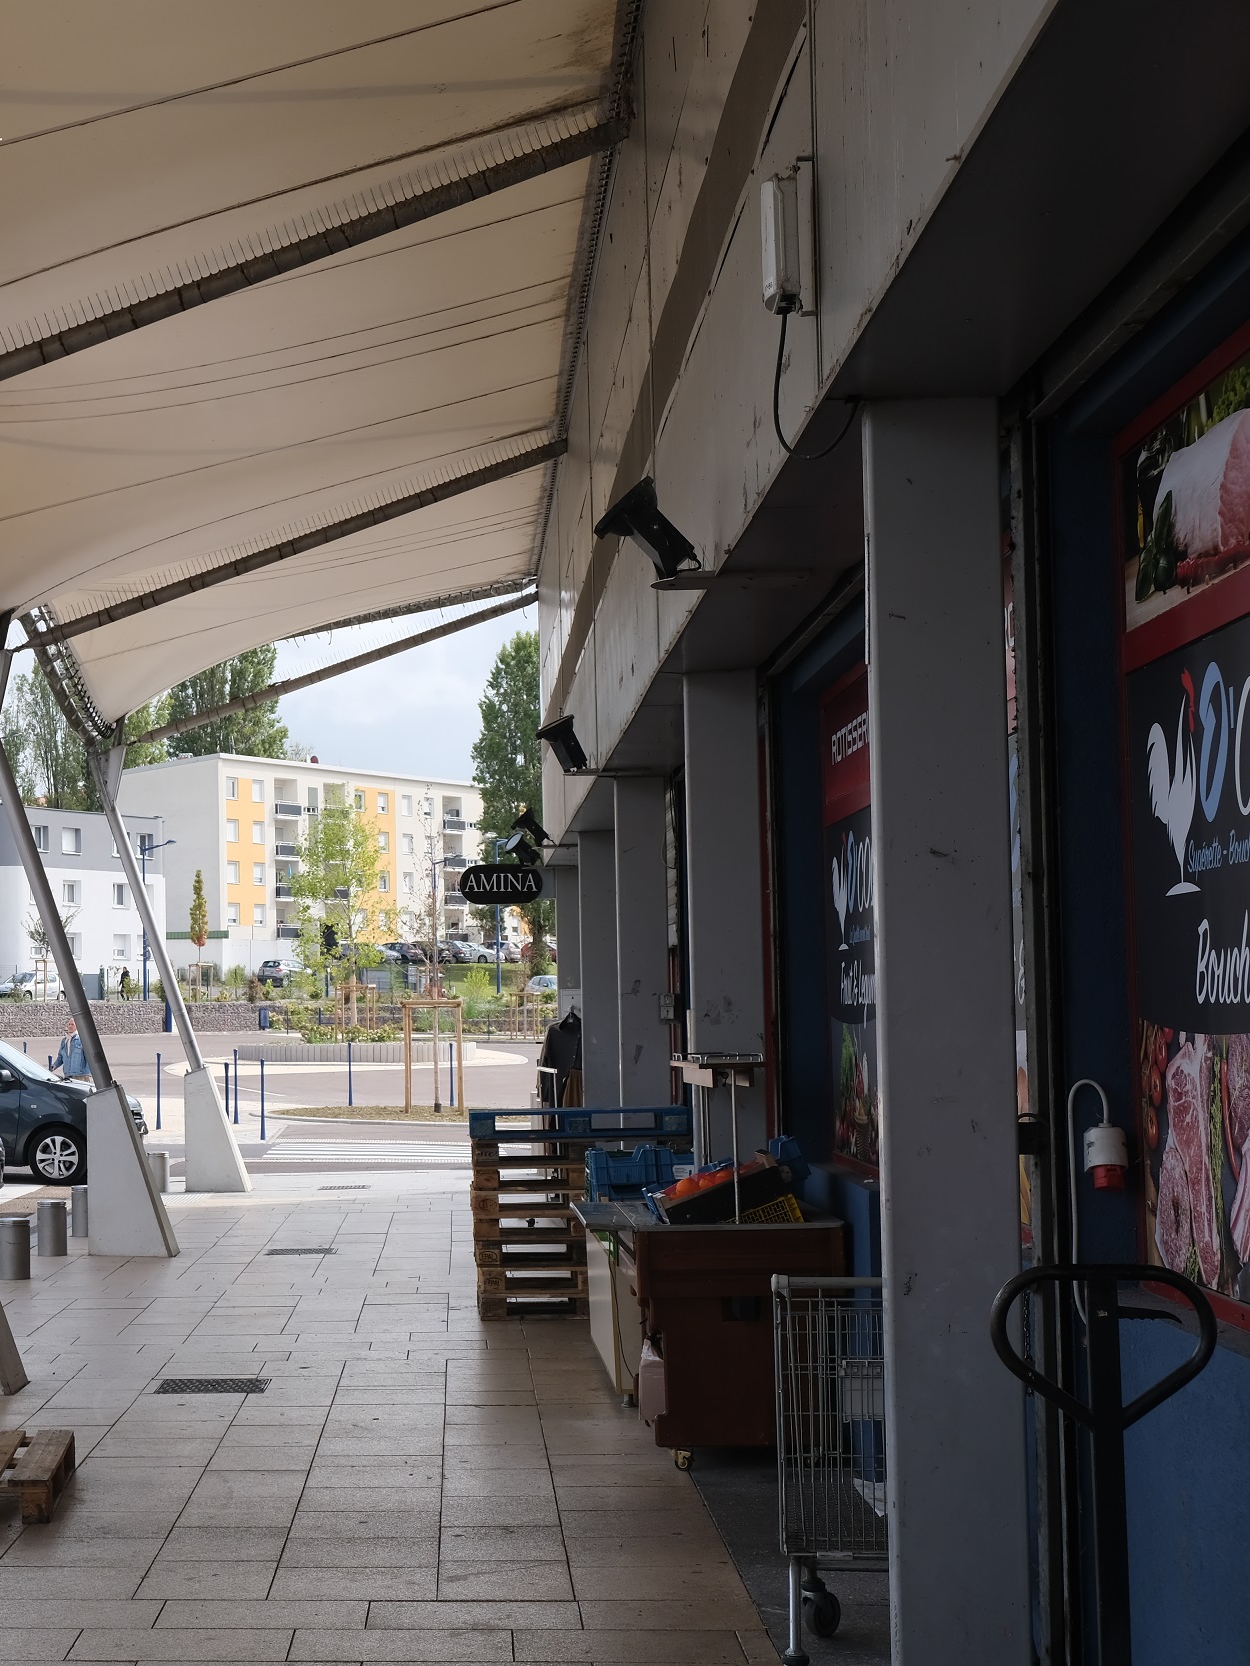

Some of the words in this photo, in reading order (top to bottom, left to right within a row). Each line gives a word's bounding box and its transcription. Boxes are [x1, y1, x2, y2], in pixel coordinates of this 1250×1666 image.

[1187, 839, 1223, 882] Supérette
[1228, 829, 1250, 866] Bouc
[464, 873, 538, 892] AMINA
[840, 961, 853, 1006] Fruit
[852, 959, 858, 1006] &
